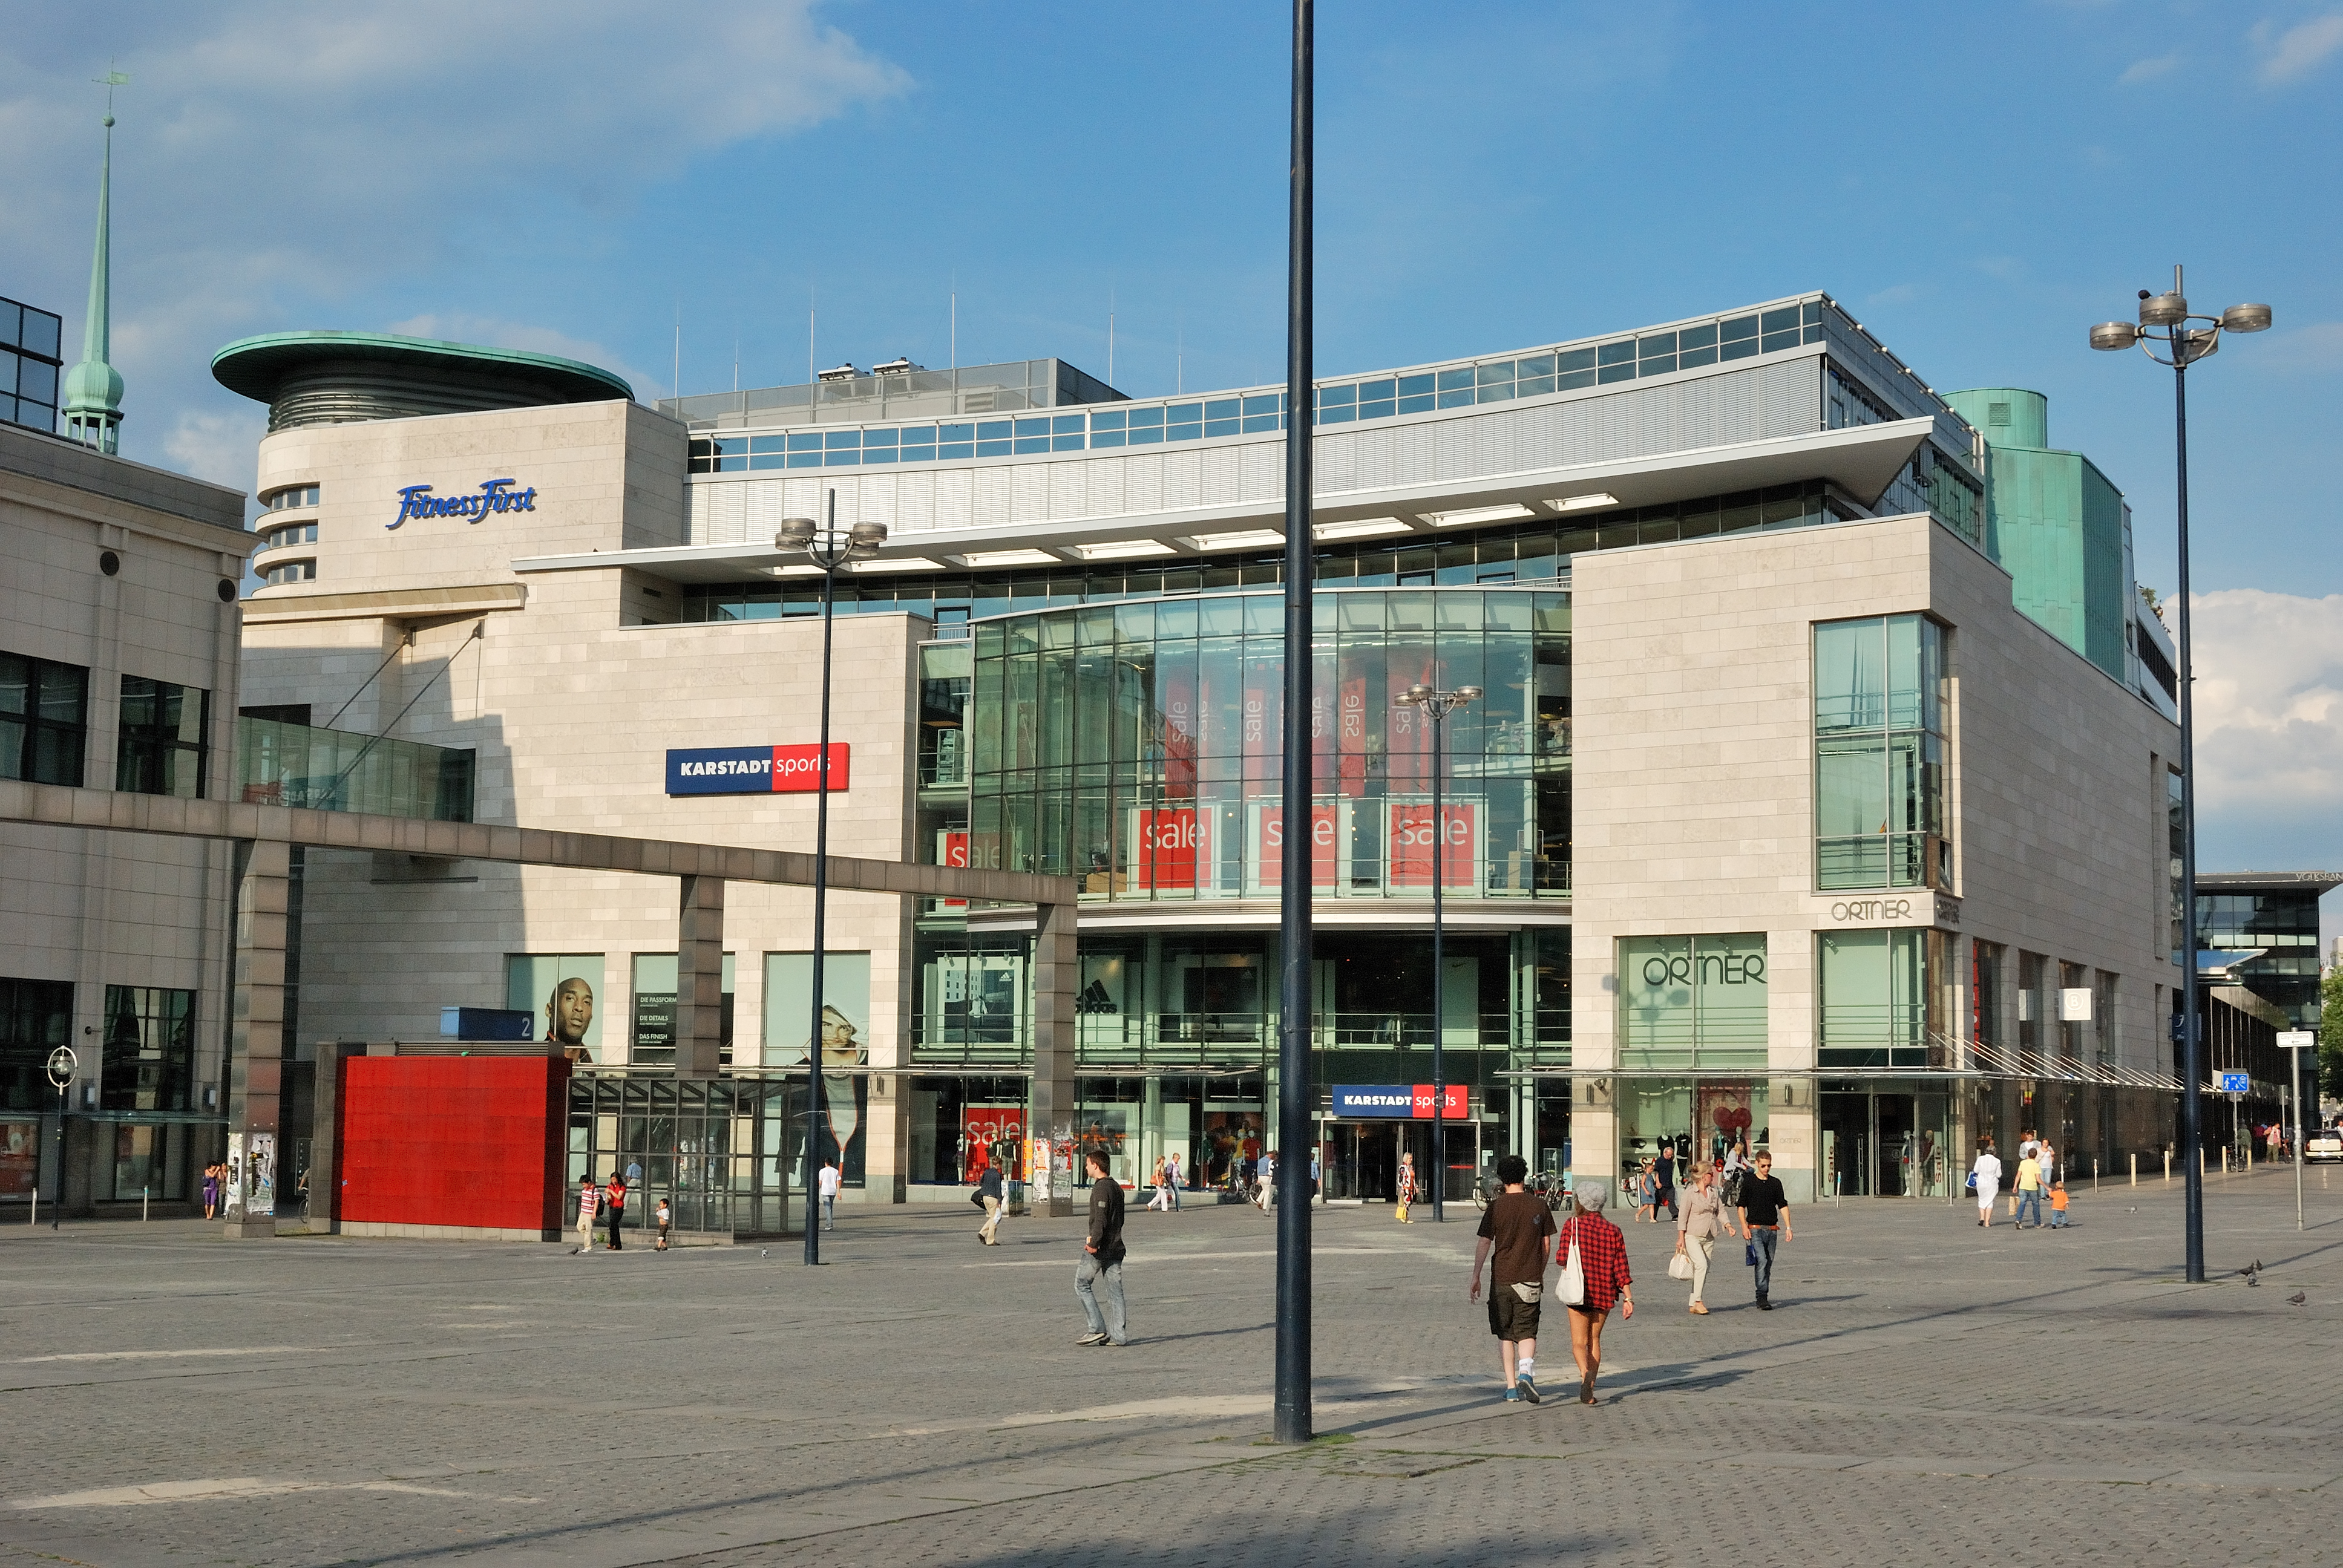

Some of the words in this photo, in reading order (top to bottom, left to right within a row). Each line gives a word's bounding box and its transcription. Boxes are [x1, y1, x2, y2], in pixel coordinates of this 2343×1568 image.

[385, 485, 479, 528] Fitness
[467, 479, 535, 523] First
[1168, 702, 1187, 742] sale
[1246, 701, 1262, 742] sale
[1392, 706, 1411, 733] sal
[681, 760, 772, 776] KARSTADT
[1145, 814, 1206, 849] sale
[1267, 819, 1334, 846] se
[1398, 811, 1467, 845] sale
[1831, 899, 1912, 921] ORTNER
[1643, 954, 1768, 986] ORTNER
[522, 1017, 530, 1037] 2
[1344, 1096, 1412, 1106] KARSTADT
[1415, 1094, 1457, 1109] spts
[968, 1114, 1021, 1145] sale
